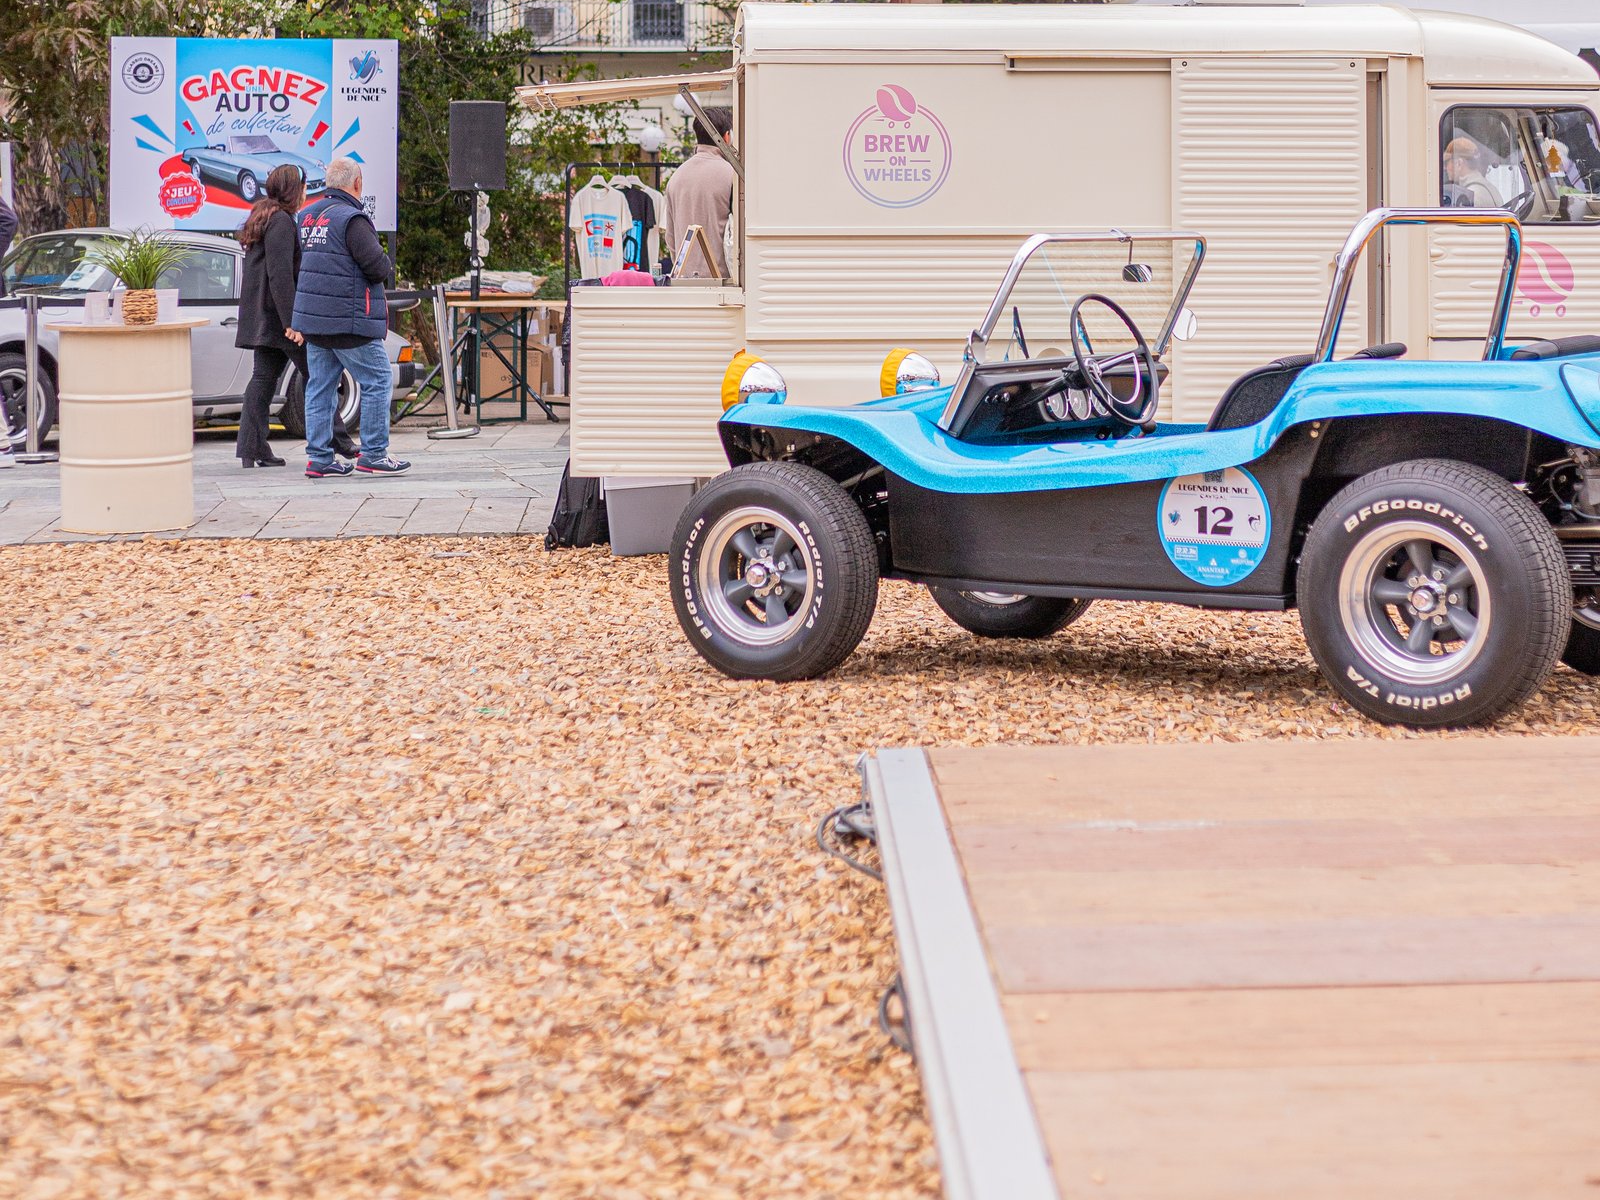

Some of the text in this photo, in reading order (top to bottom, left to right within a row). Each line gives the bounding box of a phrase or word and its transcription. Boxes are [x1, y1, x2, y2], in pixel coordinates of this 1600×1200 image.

[182, 68, 326, 106] GAGNEZ
[215, 93, 290, 113] AUTO
[206, 111, 303, 136] de collection
[864, 134, 931, 153] BREW
[888, 155, 907, 167] ON
[863, 168, 932, 182] WHEELS
[170, 186, 193, 199] JEU
[1178, 483, 1219, 493] LEGENDES
[1231, 487, 1249, 495] NICE
[1193, 505, 1234, 536] 12
[1343, 498, 1489, 551] BFGoodrich
[798, 520, 825, 590] Radial
[682, 517, 714, 640] BFGoodrich
[1346, 665, 1473, 710] Radial T/A
